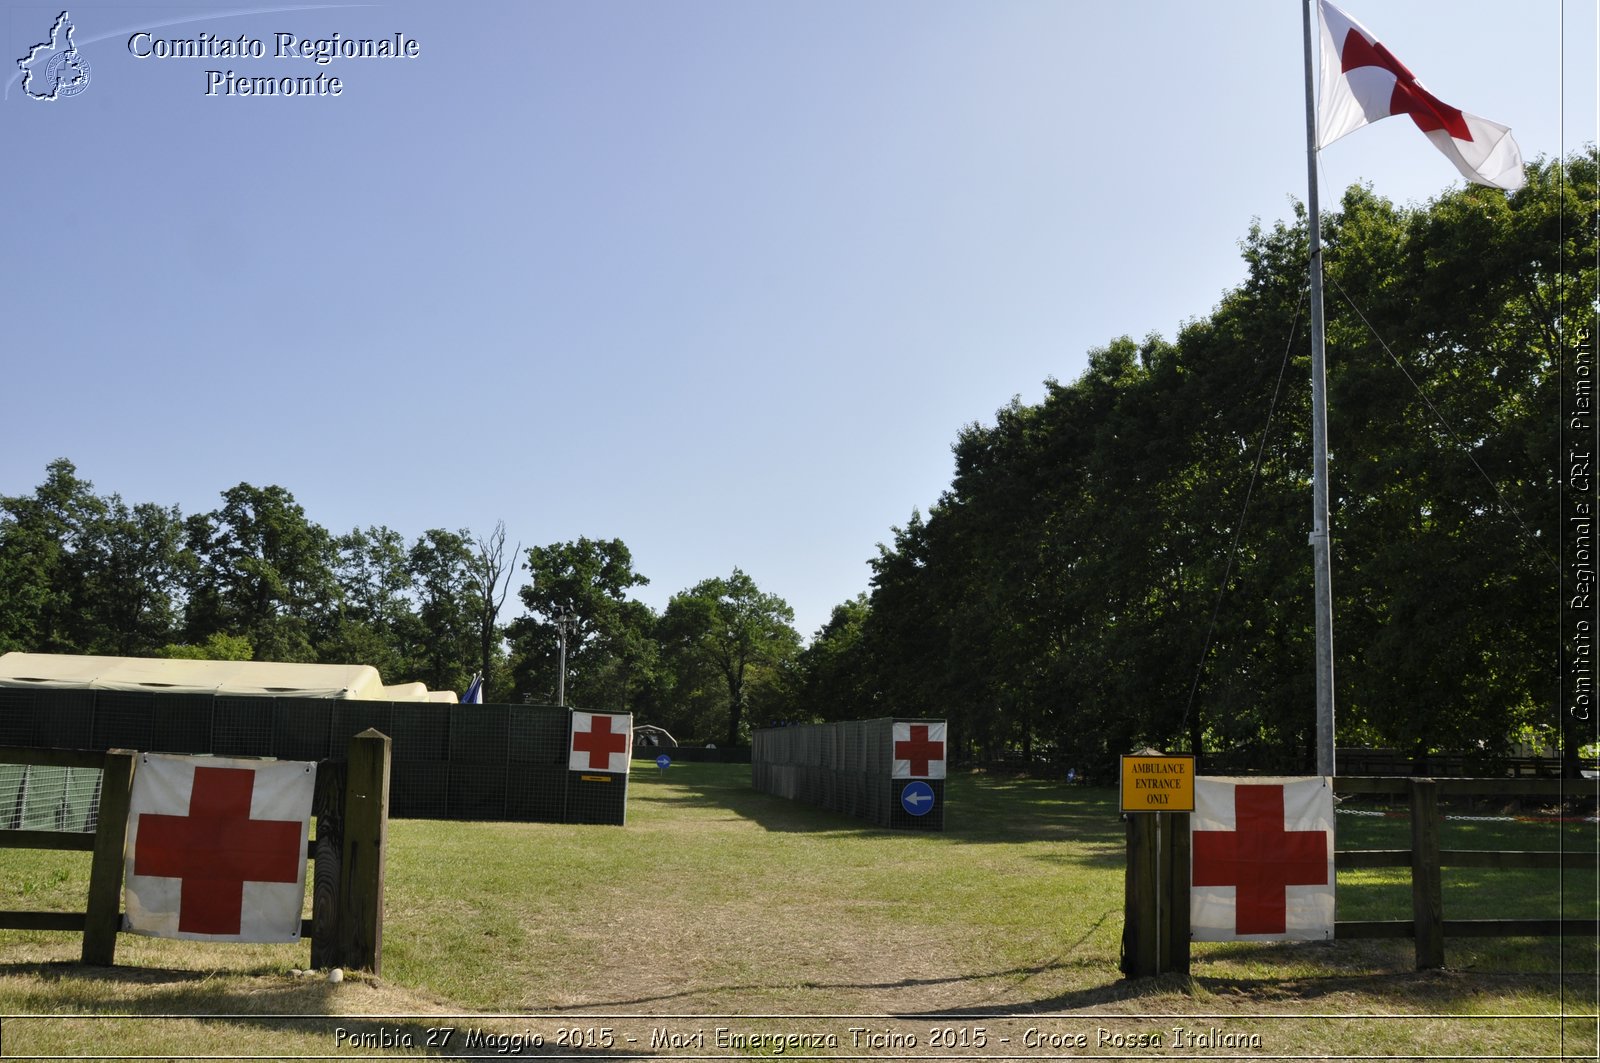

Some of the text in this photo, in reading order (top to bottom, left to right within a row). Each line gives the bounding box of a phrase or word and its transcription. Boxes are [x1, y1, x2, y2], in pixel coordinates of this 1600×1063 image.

[1132, 763, 1185, 774] AMBULANCE
[1135, 778, 1182, 789] ENTRANCE
[1146, 793, 1170, 804] ONLY
